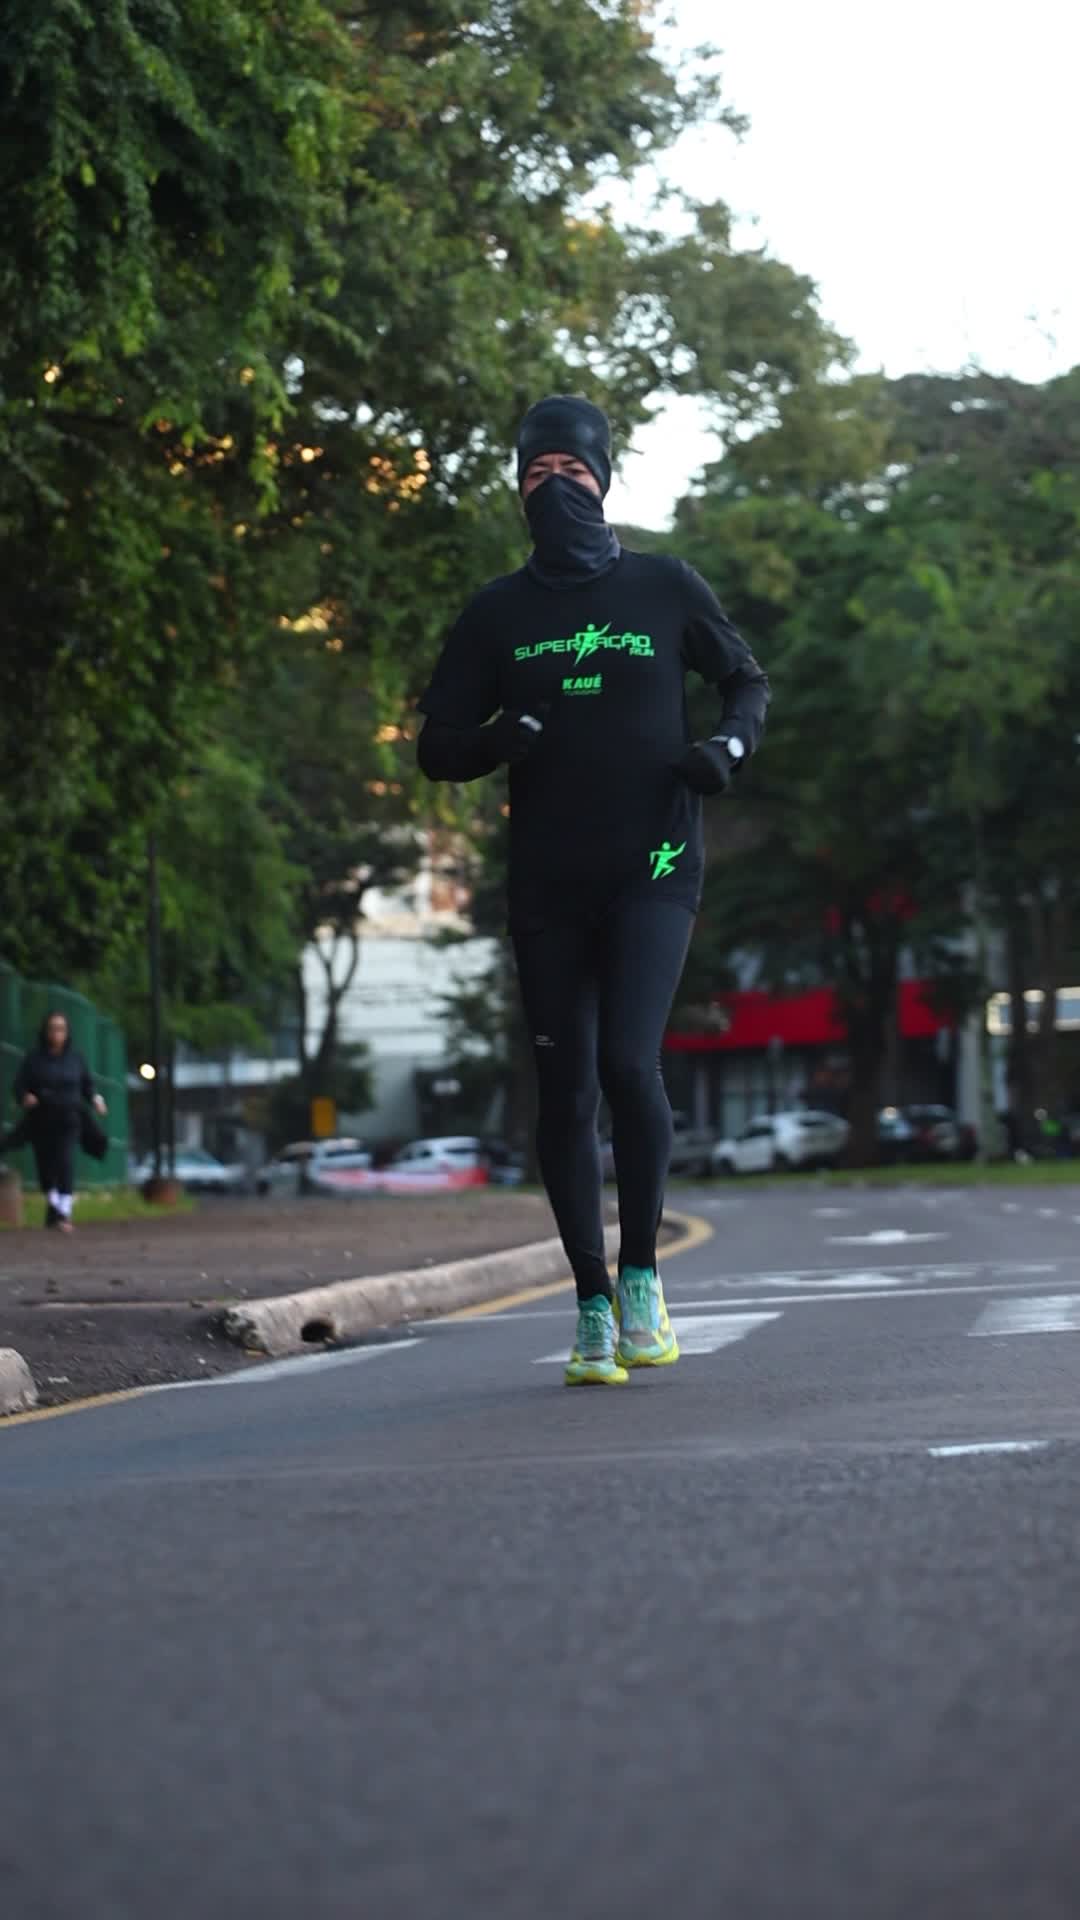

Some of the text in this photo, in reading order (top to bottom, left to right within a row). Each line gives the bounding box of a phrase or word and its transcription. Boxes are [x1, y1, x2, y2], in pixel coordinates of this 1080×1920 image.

[514, 632, 651, 661] SUPERAÇÃO
[629, 648, 656, 657] RUN
[562, 673, 603, 690] KAUÉ
